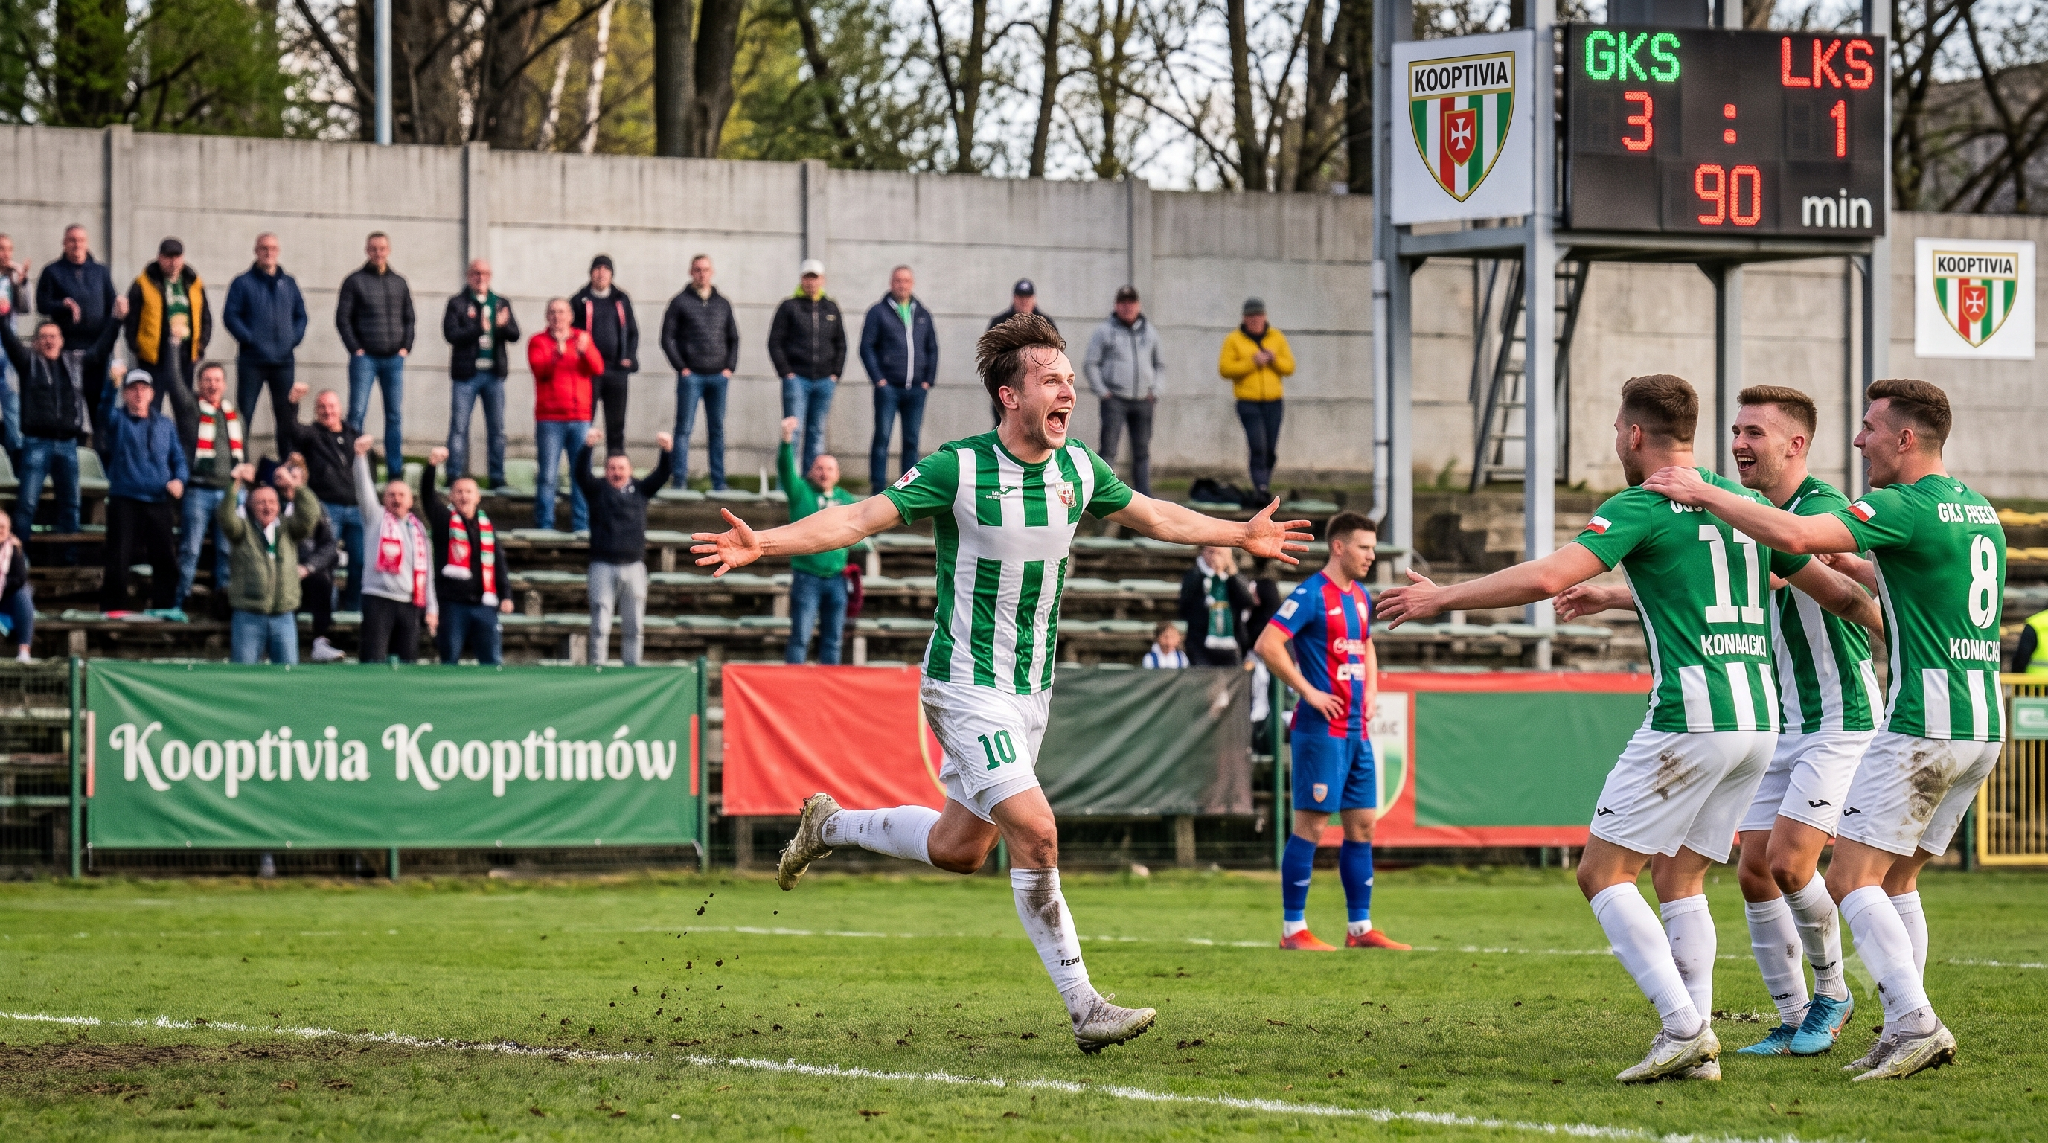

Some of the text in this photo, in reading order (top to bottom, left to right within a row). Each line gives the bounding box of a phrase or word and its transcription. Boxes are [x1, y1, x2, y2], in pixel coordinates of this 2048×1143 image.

[1414, 61, 1509, 93] KOOPTIVIA
[1585, 30, 1875, 90] GKS LKS
[1621, 91, 1654, 151] 3
[1830, 99, 1847, 158] 1
[1694, 163, 1873, 229] 90 min
[1938, 256, 2013, 274] KOOPTIVIA
[1698, 524, 1765, 625] 11
[1968, 533, 1999, 629] 8
[108, 721, 677, 798] Kooptivia Kooptimów
[977, 729, 1017, 772] 10
